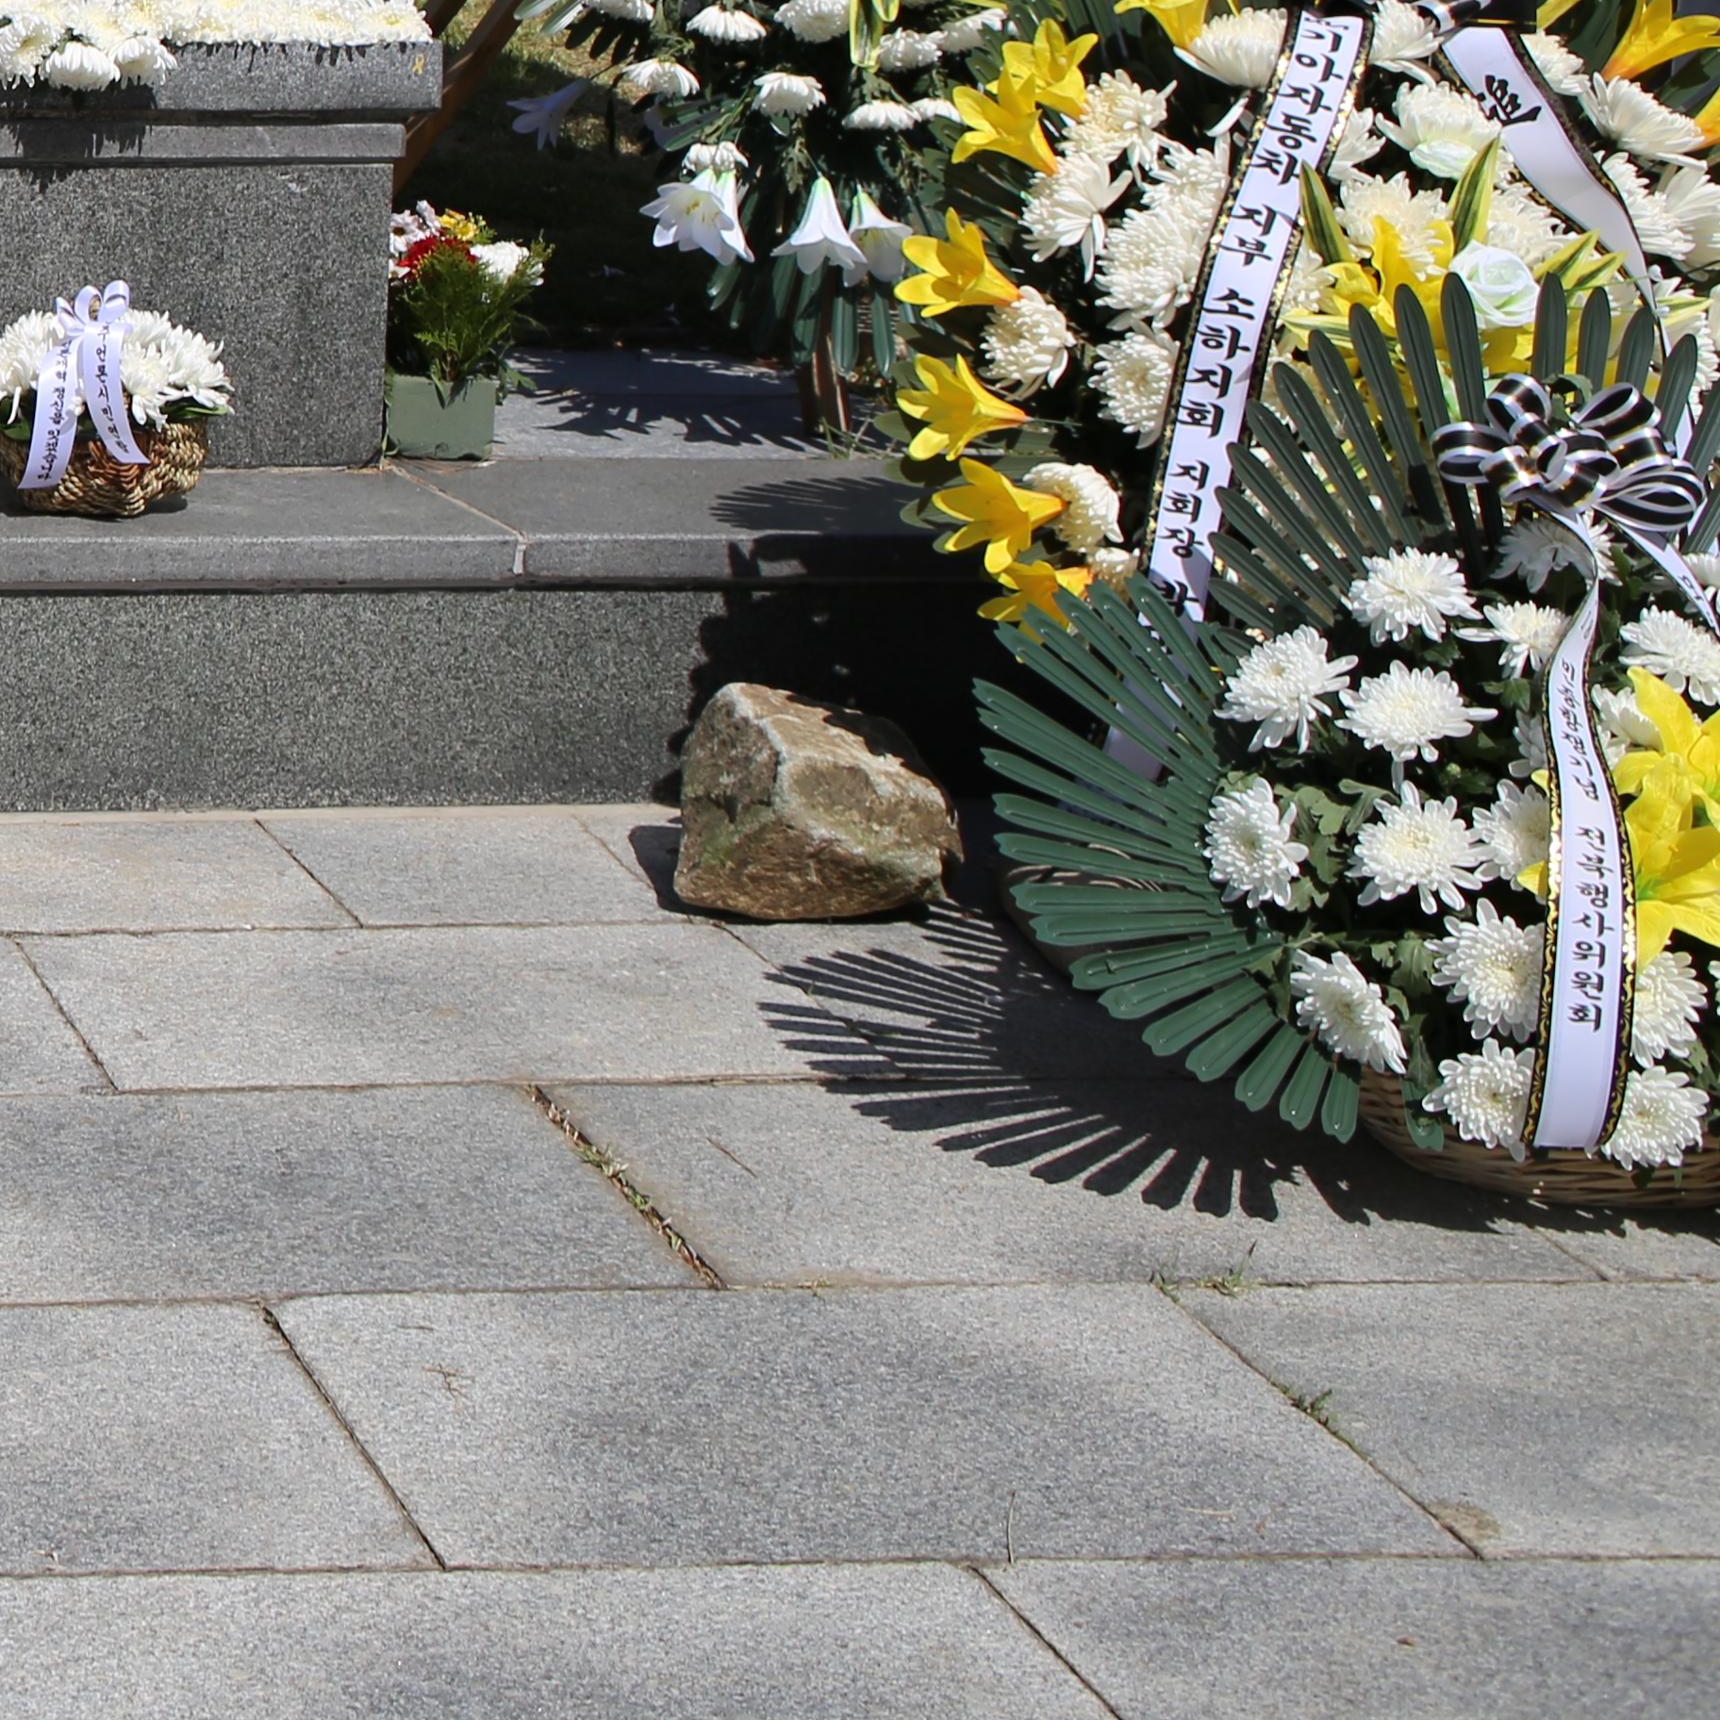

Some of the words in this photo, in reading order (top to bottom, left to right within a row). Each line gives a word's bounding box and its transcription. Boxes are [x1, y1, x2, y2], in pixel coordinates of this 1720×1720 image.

[1220, 203, 1274, 268] 지부
[95, 324, 130, 454] 주언론시민연합
[1175, 286, 1255, 439] 소하지회
[1157, 459, 1211, 560] 지회장
[1567, 826, 1616, 1032] 전북행사위원회
